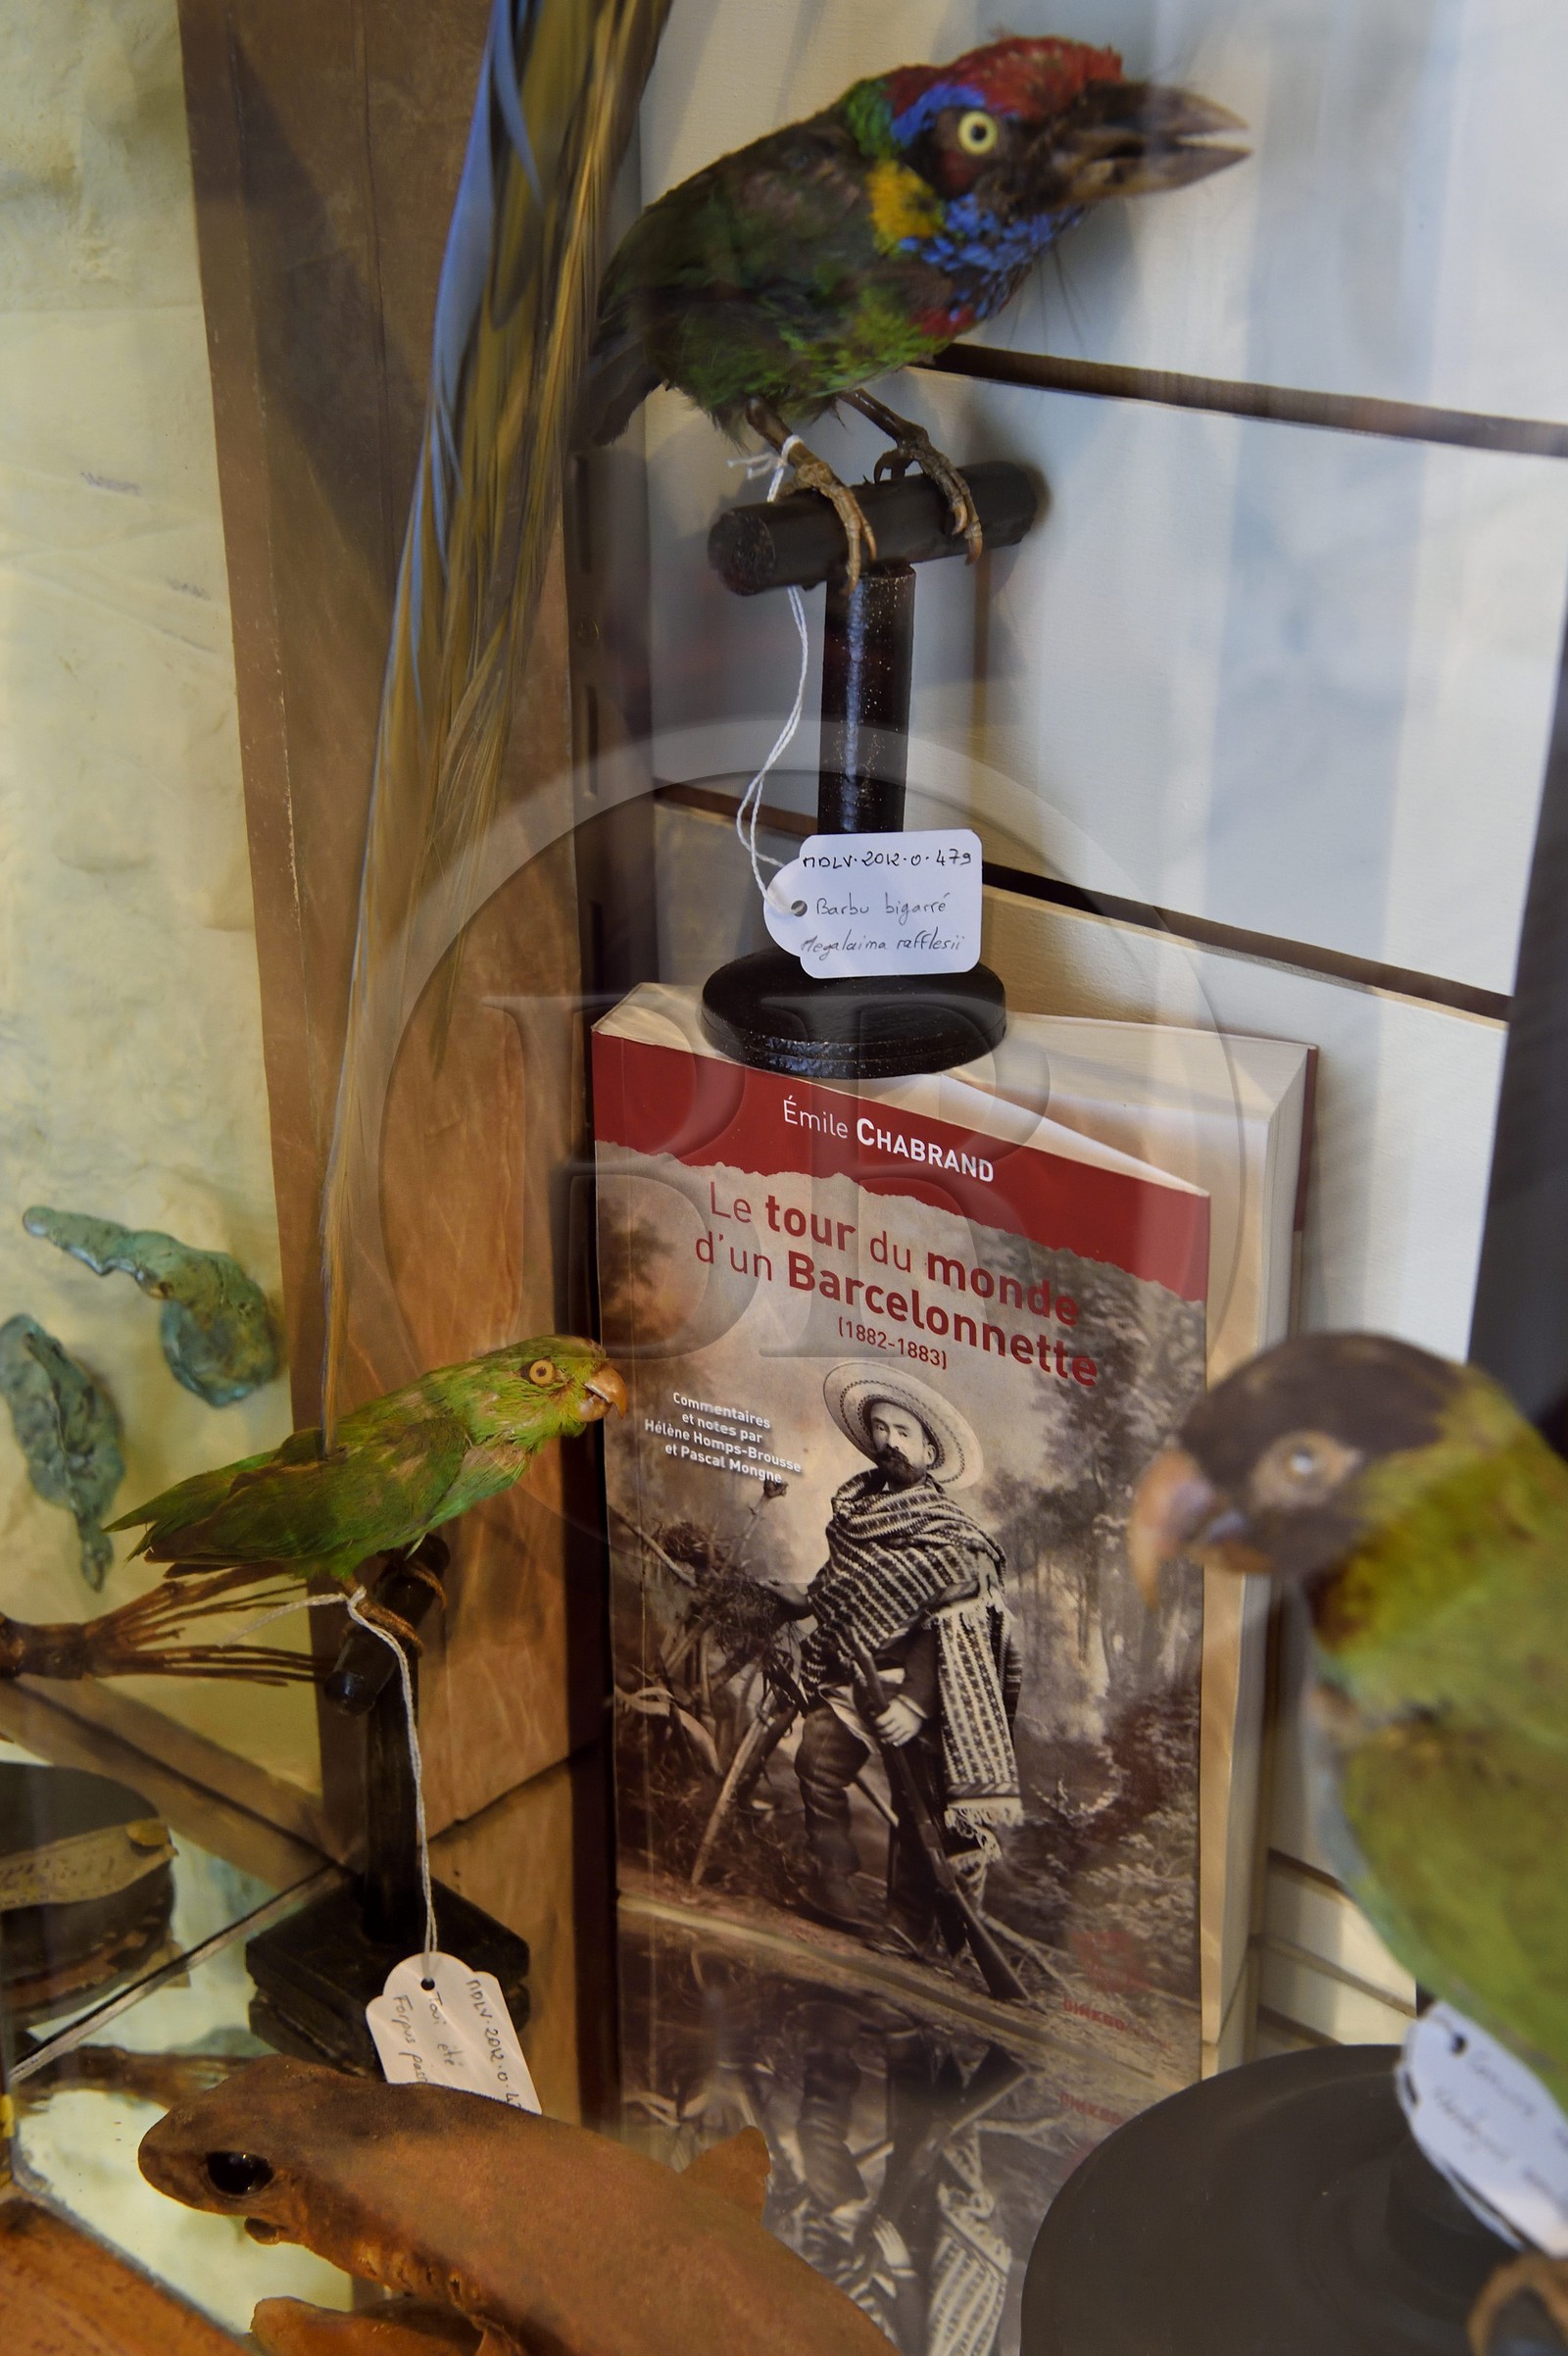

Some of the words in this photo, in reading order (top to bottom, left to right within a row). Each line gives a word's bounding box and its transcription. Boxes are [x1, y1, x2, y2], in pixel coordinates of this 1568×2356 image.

[816, 893, 869, 915] Barbu
[885, 893, 950, 925] bigarré
[783, 1095, 849, 1139] Émile
[857, 1117, 994, 1183] CHABRAND
[710, 1181, 752, 1223] Le
[765, 1195, 856, 1252] tour
[870, 1230, 911, 1273] du
[927, 1252, 1079, 1327] monde
[696, 1231, 772, 1282] d'un
[788, 1250, 1098, 1387] Barcelonnette
[838, 1316, 947, 1370] (1882-1883)
[673, 1392, 771, 1429] Commentaires
[682, 1413, 695, 1426] et
[697, 1417, 737, 1437] notes
[740, 1429, 763, 1444] par
[645, 1418, 691, 1441] Hélène
[693, 1431, 802, 1473] Homps-Brousse
[665, 1443, 678, 1456] et
[681, 1446, 726, 1469] Pascal
[729, 1458, 782, 1484] Mongne
